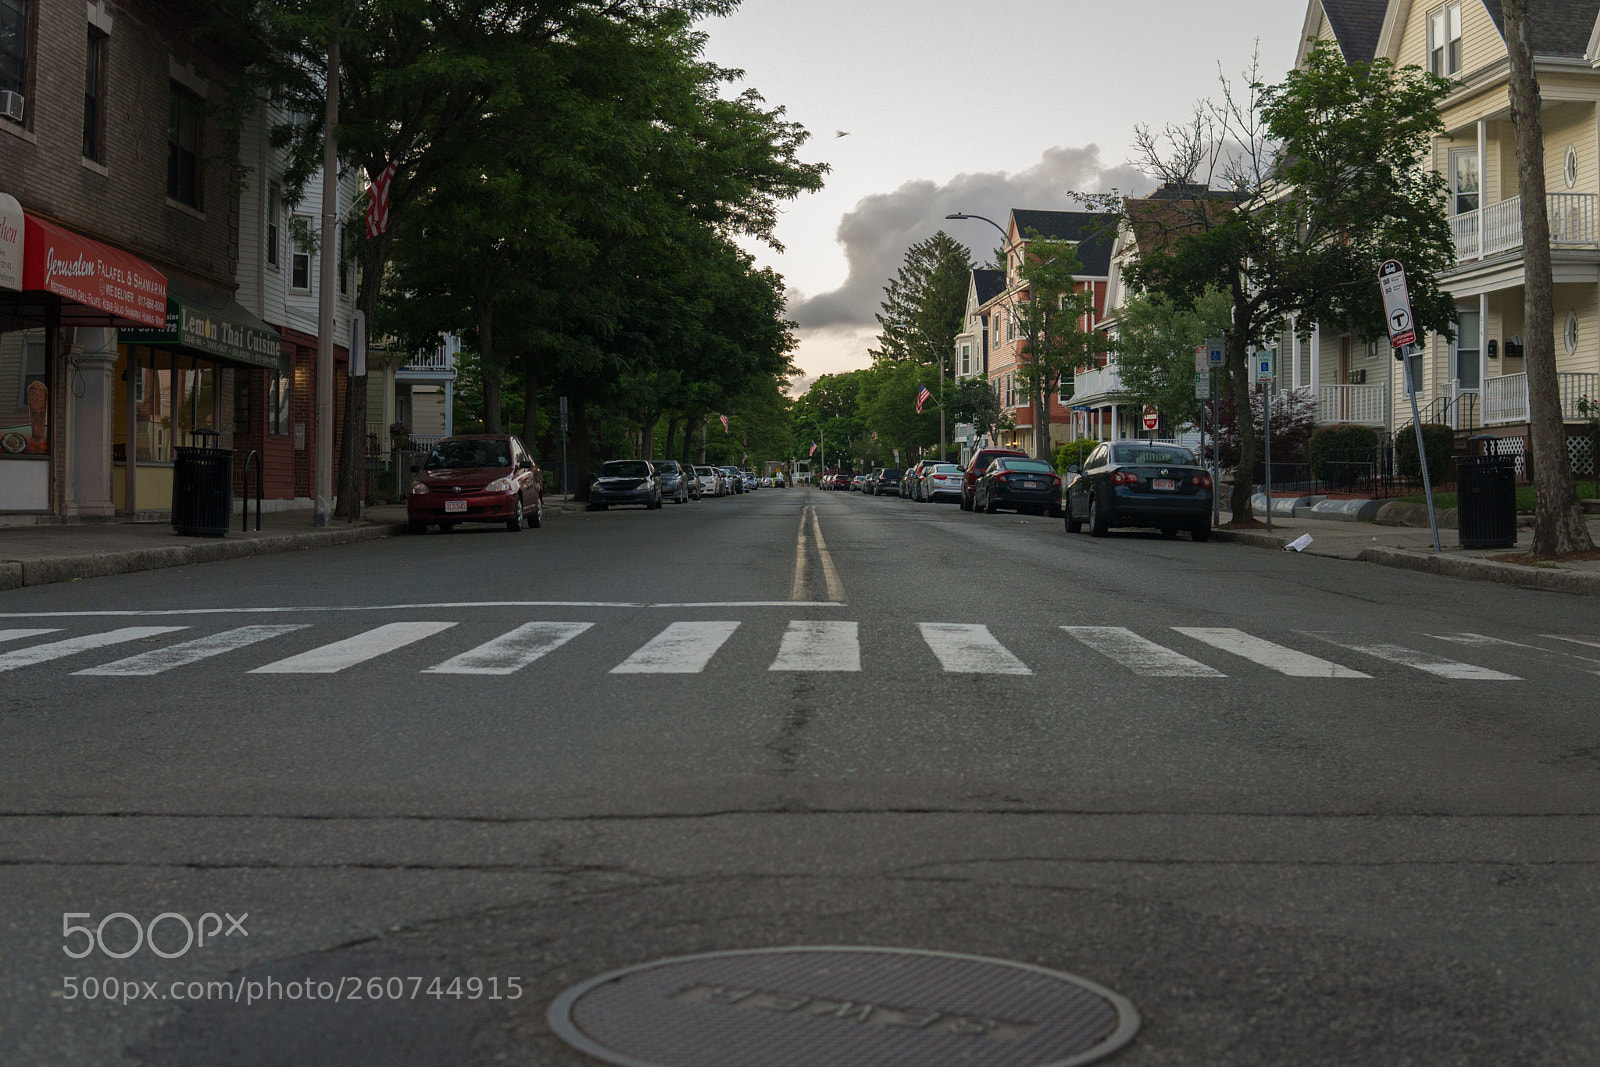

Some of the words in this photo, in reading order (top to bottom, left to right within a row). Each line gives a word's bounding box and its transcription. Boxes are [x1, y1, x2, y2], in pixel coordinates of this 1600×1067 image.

[45, 246, 96, 285] Jerusalem
[97, 259, 125, 283] FALAFEL
[127, 270, 132, 286] &
[133, 273, 167, 298] SHAWARMA
[105, 284, 114, 297] WE
[114, 286, 135, 303] DELIVER
[1392, 313, 1405, 327] T
[221, 321, 243, 348] Thai
[247, 330, 281, 357] Cuisine
